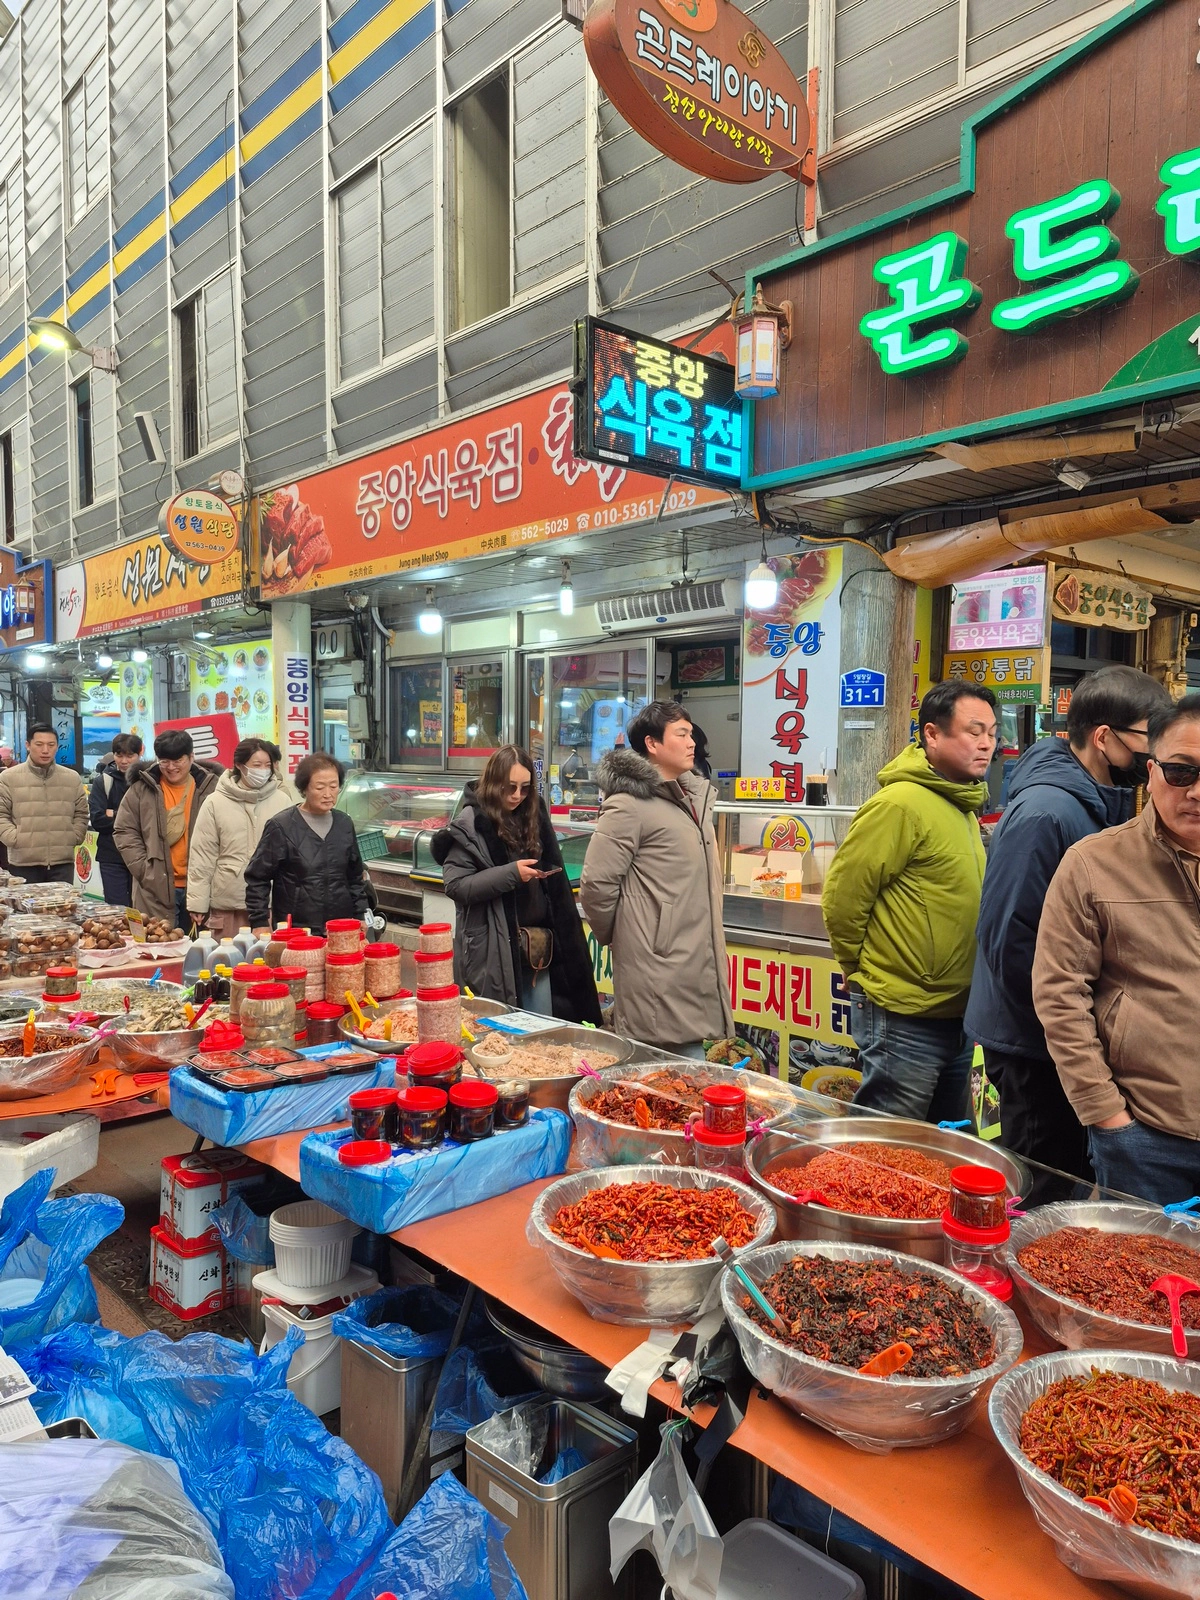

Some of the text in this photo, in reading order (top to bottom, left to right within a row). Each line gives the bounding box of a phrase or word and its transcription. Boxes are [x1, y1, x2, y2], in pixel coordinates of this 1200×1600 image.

[635, 8, 797, 146] 곤드레이야기
[634, 341, 708, 399] 중앙
[599, 376, 742, 476] 식육점
[356, 422, 522, 538] 중앙식육점
[185, 497, 223, 512] 향토음식
[480, 534, 507, 550] 中央肉屋
[521, 517, 569, 541] 562-5029
[399, 549, 449, 569] Jung ang Meat Shop
[1012, 575, 1043, 586] 모범업소
[1080, 582, 1150, 624] 중앙식육점
[764, 621, 825, 658] 중앙
[953, 623, 1041, 649] 중앙식육점
[949, 656, 1036, 682] 중앙통닭
[845, 688, 879, 702] 31-1
[287, 658, 309, 775] 중앙식육점
[57, 708, 70, 765] 어서오세요
